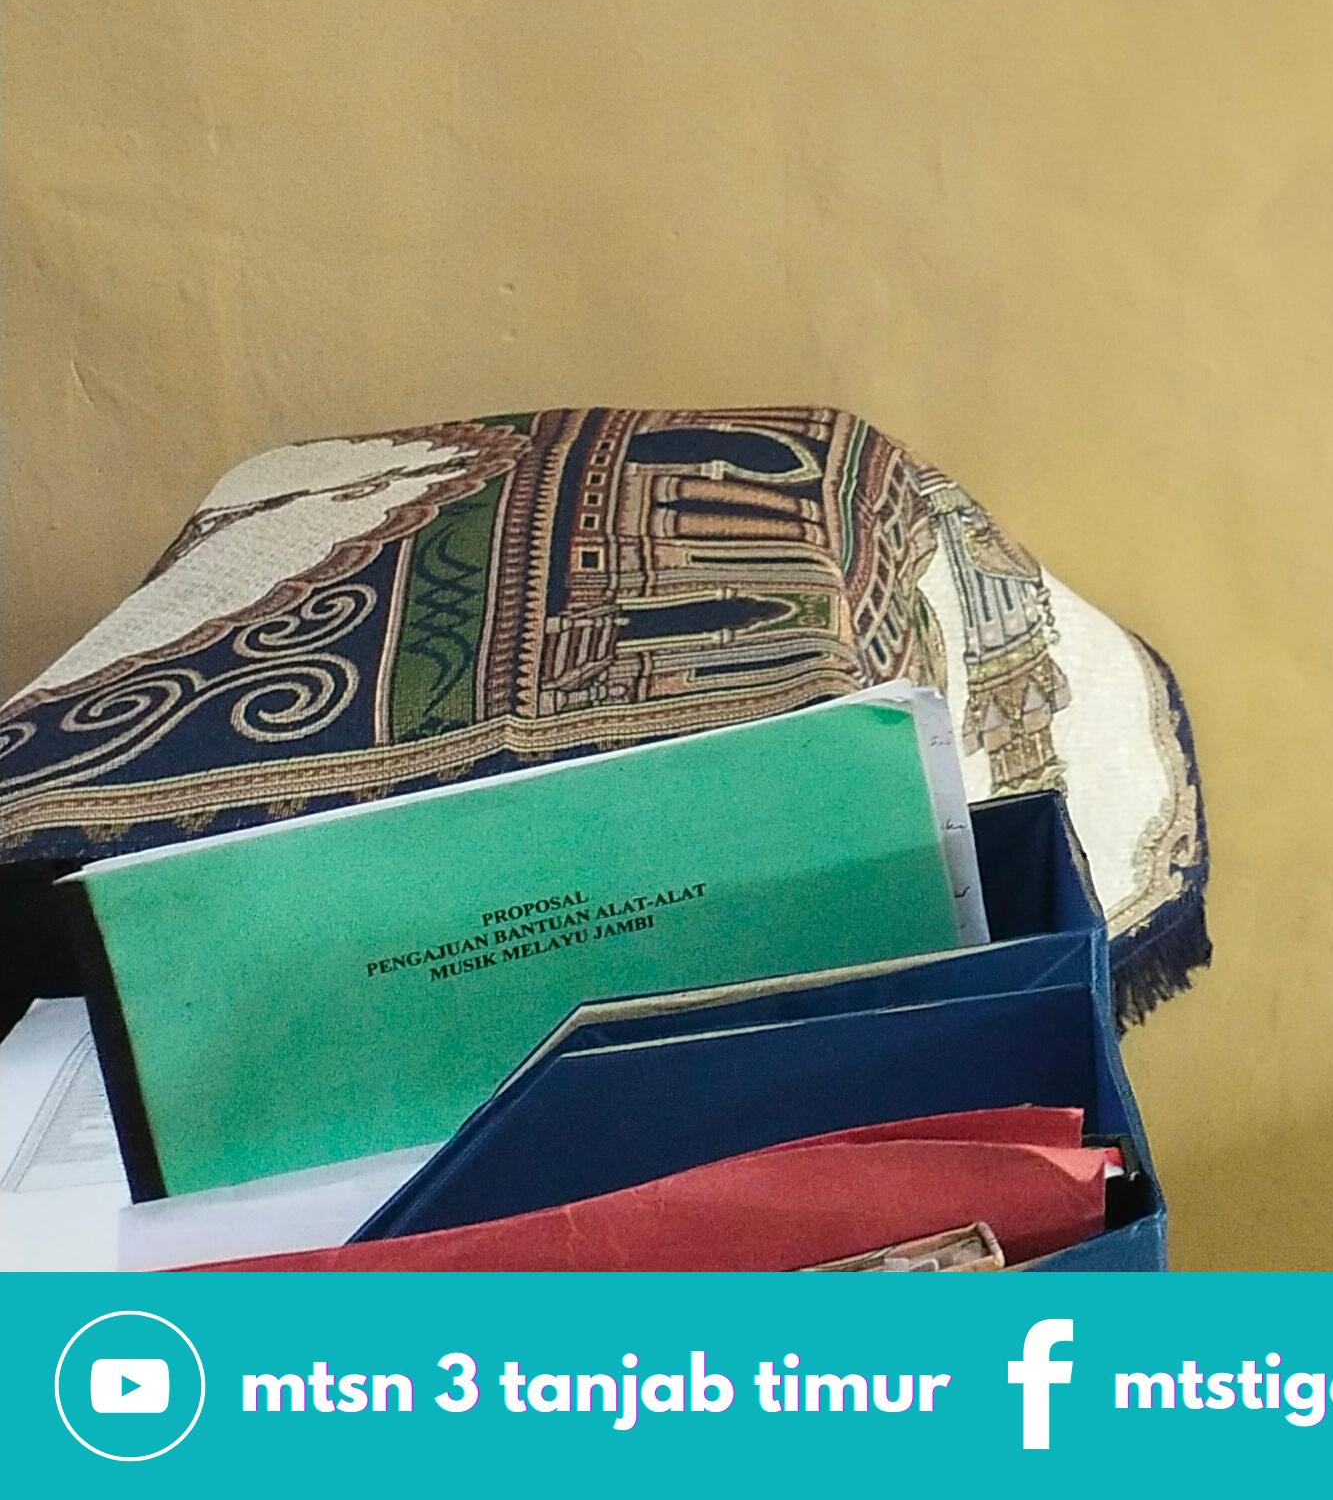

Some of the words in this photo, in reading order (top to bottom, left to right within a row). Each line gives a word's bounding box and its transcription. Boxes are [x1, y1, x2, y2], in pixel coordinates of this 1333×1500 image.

[366, 933, 489, 978] PENGAJUAN
[493, 910, 590, 944] BANTUAN
[595, 883, 706, 920] ALAT-ALAT
[482, 890, 589, 927] PROPOSAL
[430, 954, 497, 982] MUSIK
[502, 928, 588, 962] MELAYU
[593, 914, 654, 940] JAMBI
